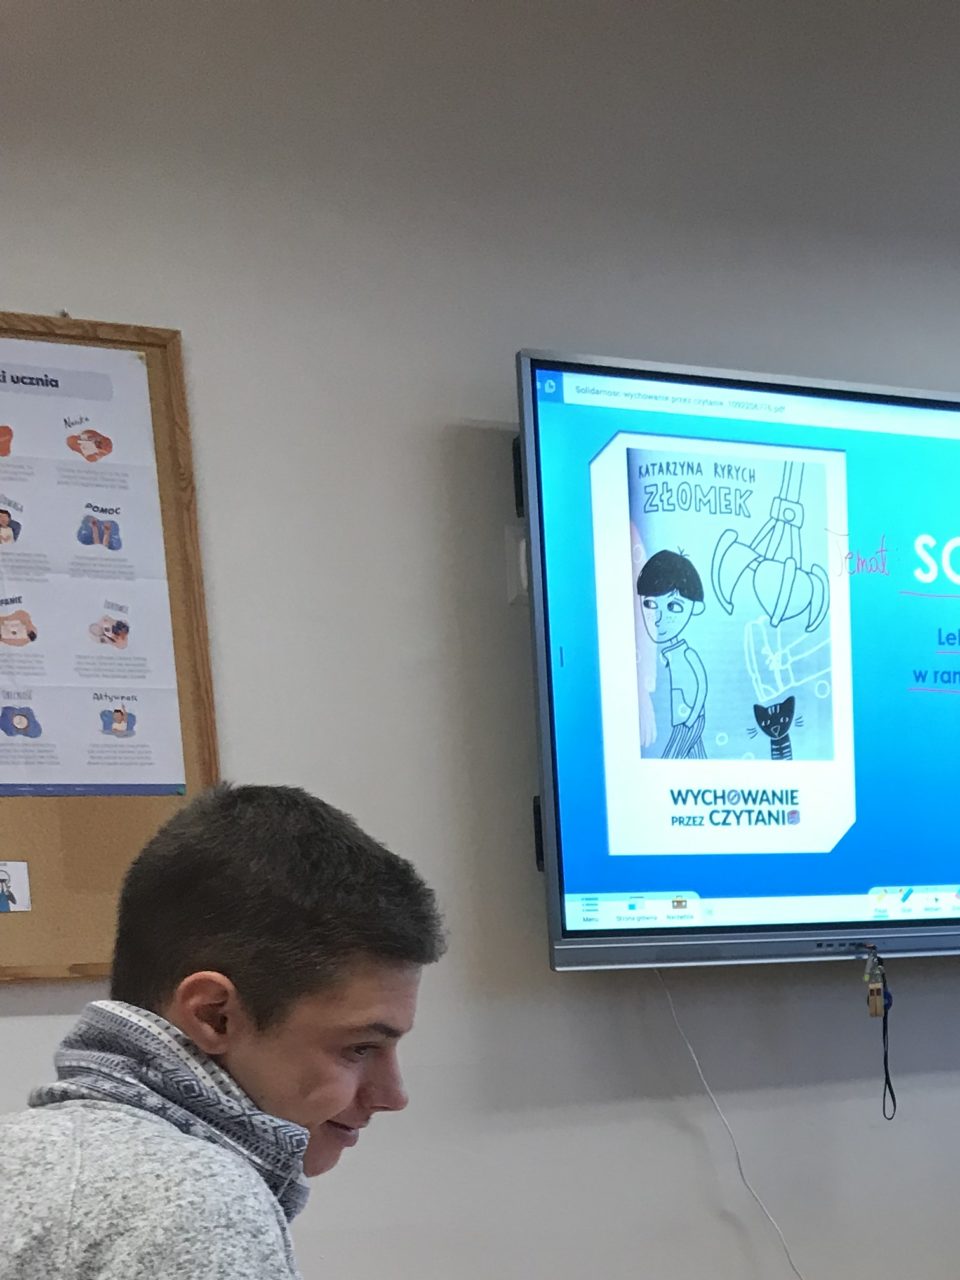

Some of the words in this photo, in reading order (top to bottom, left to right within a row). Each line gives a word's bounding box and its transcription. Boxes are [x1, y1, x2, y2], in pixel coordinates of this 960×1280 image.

[10, 374, 60, 388] ucznia
[638, 461, 703, 479] KATARZYNA
[713, 462, 756, 483] RYRYCH
[643, 481, 754, 518] ZŁOMEK
[85, 502, 121, 515] POMOC
[913, 669, 928, 683] w
[669, 789, 800, 806] WYCHOWANIE
[671, 816, 705, 826] PRZEZ
